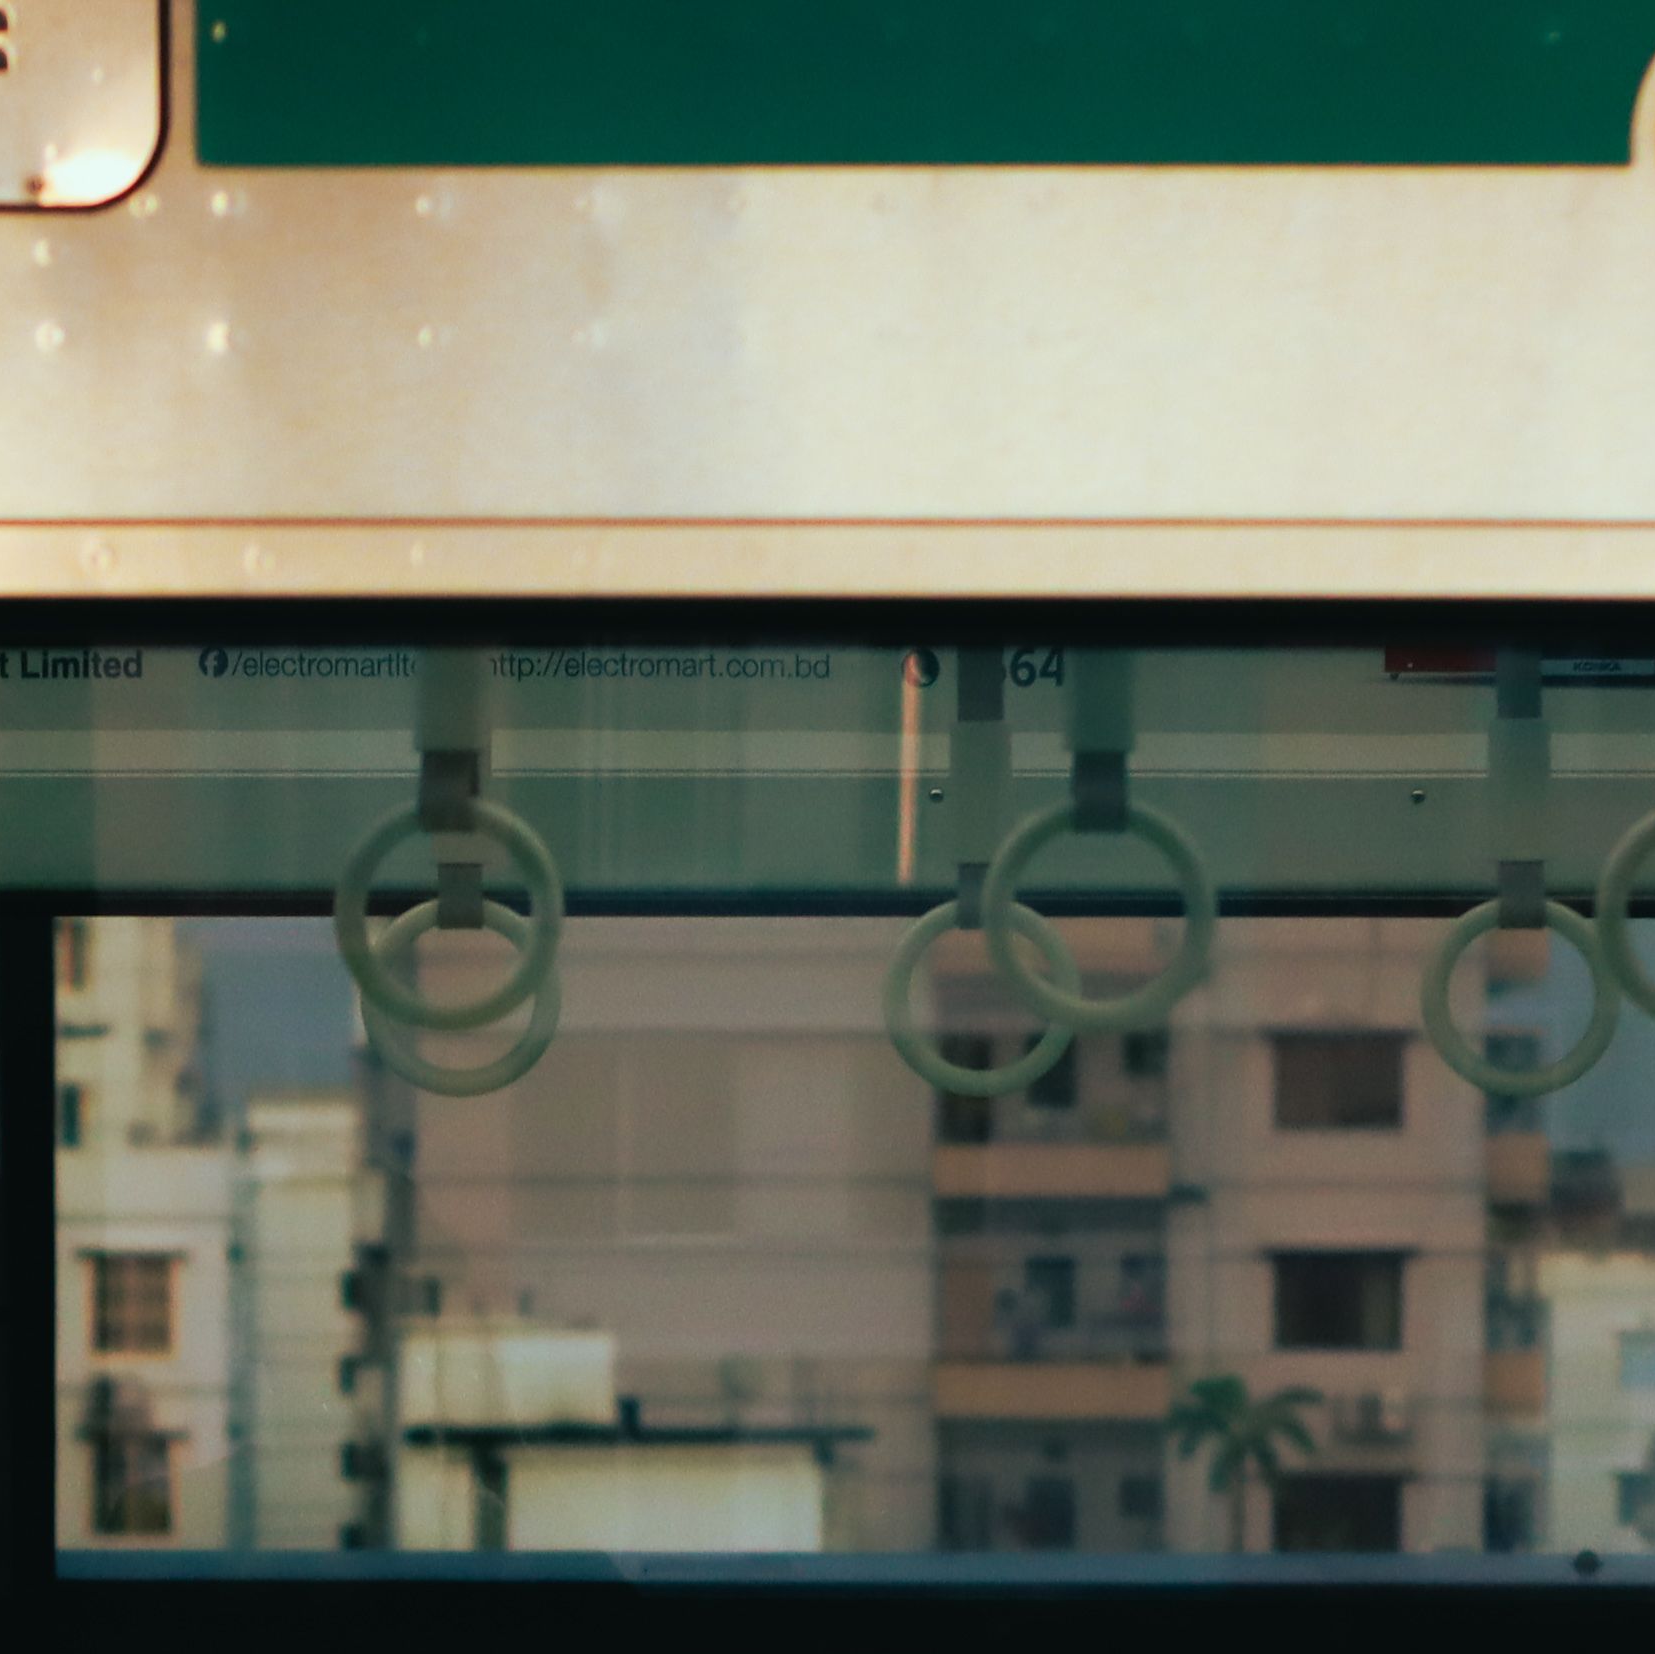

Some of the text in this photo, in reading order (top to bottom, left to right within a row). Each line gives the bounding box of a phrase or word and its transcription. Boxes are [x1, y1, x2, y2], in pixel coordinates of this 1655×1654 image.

[20, 649, 143, 679] Limited
[231, 651, 416, 678] /electromartlt
[1002, 647, 1065, 688] 64
